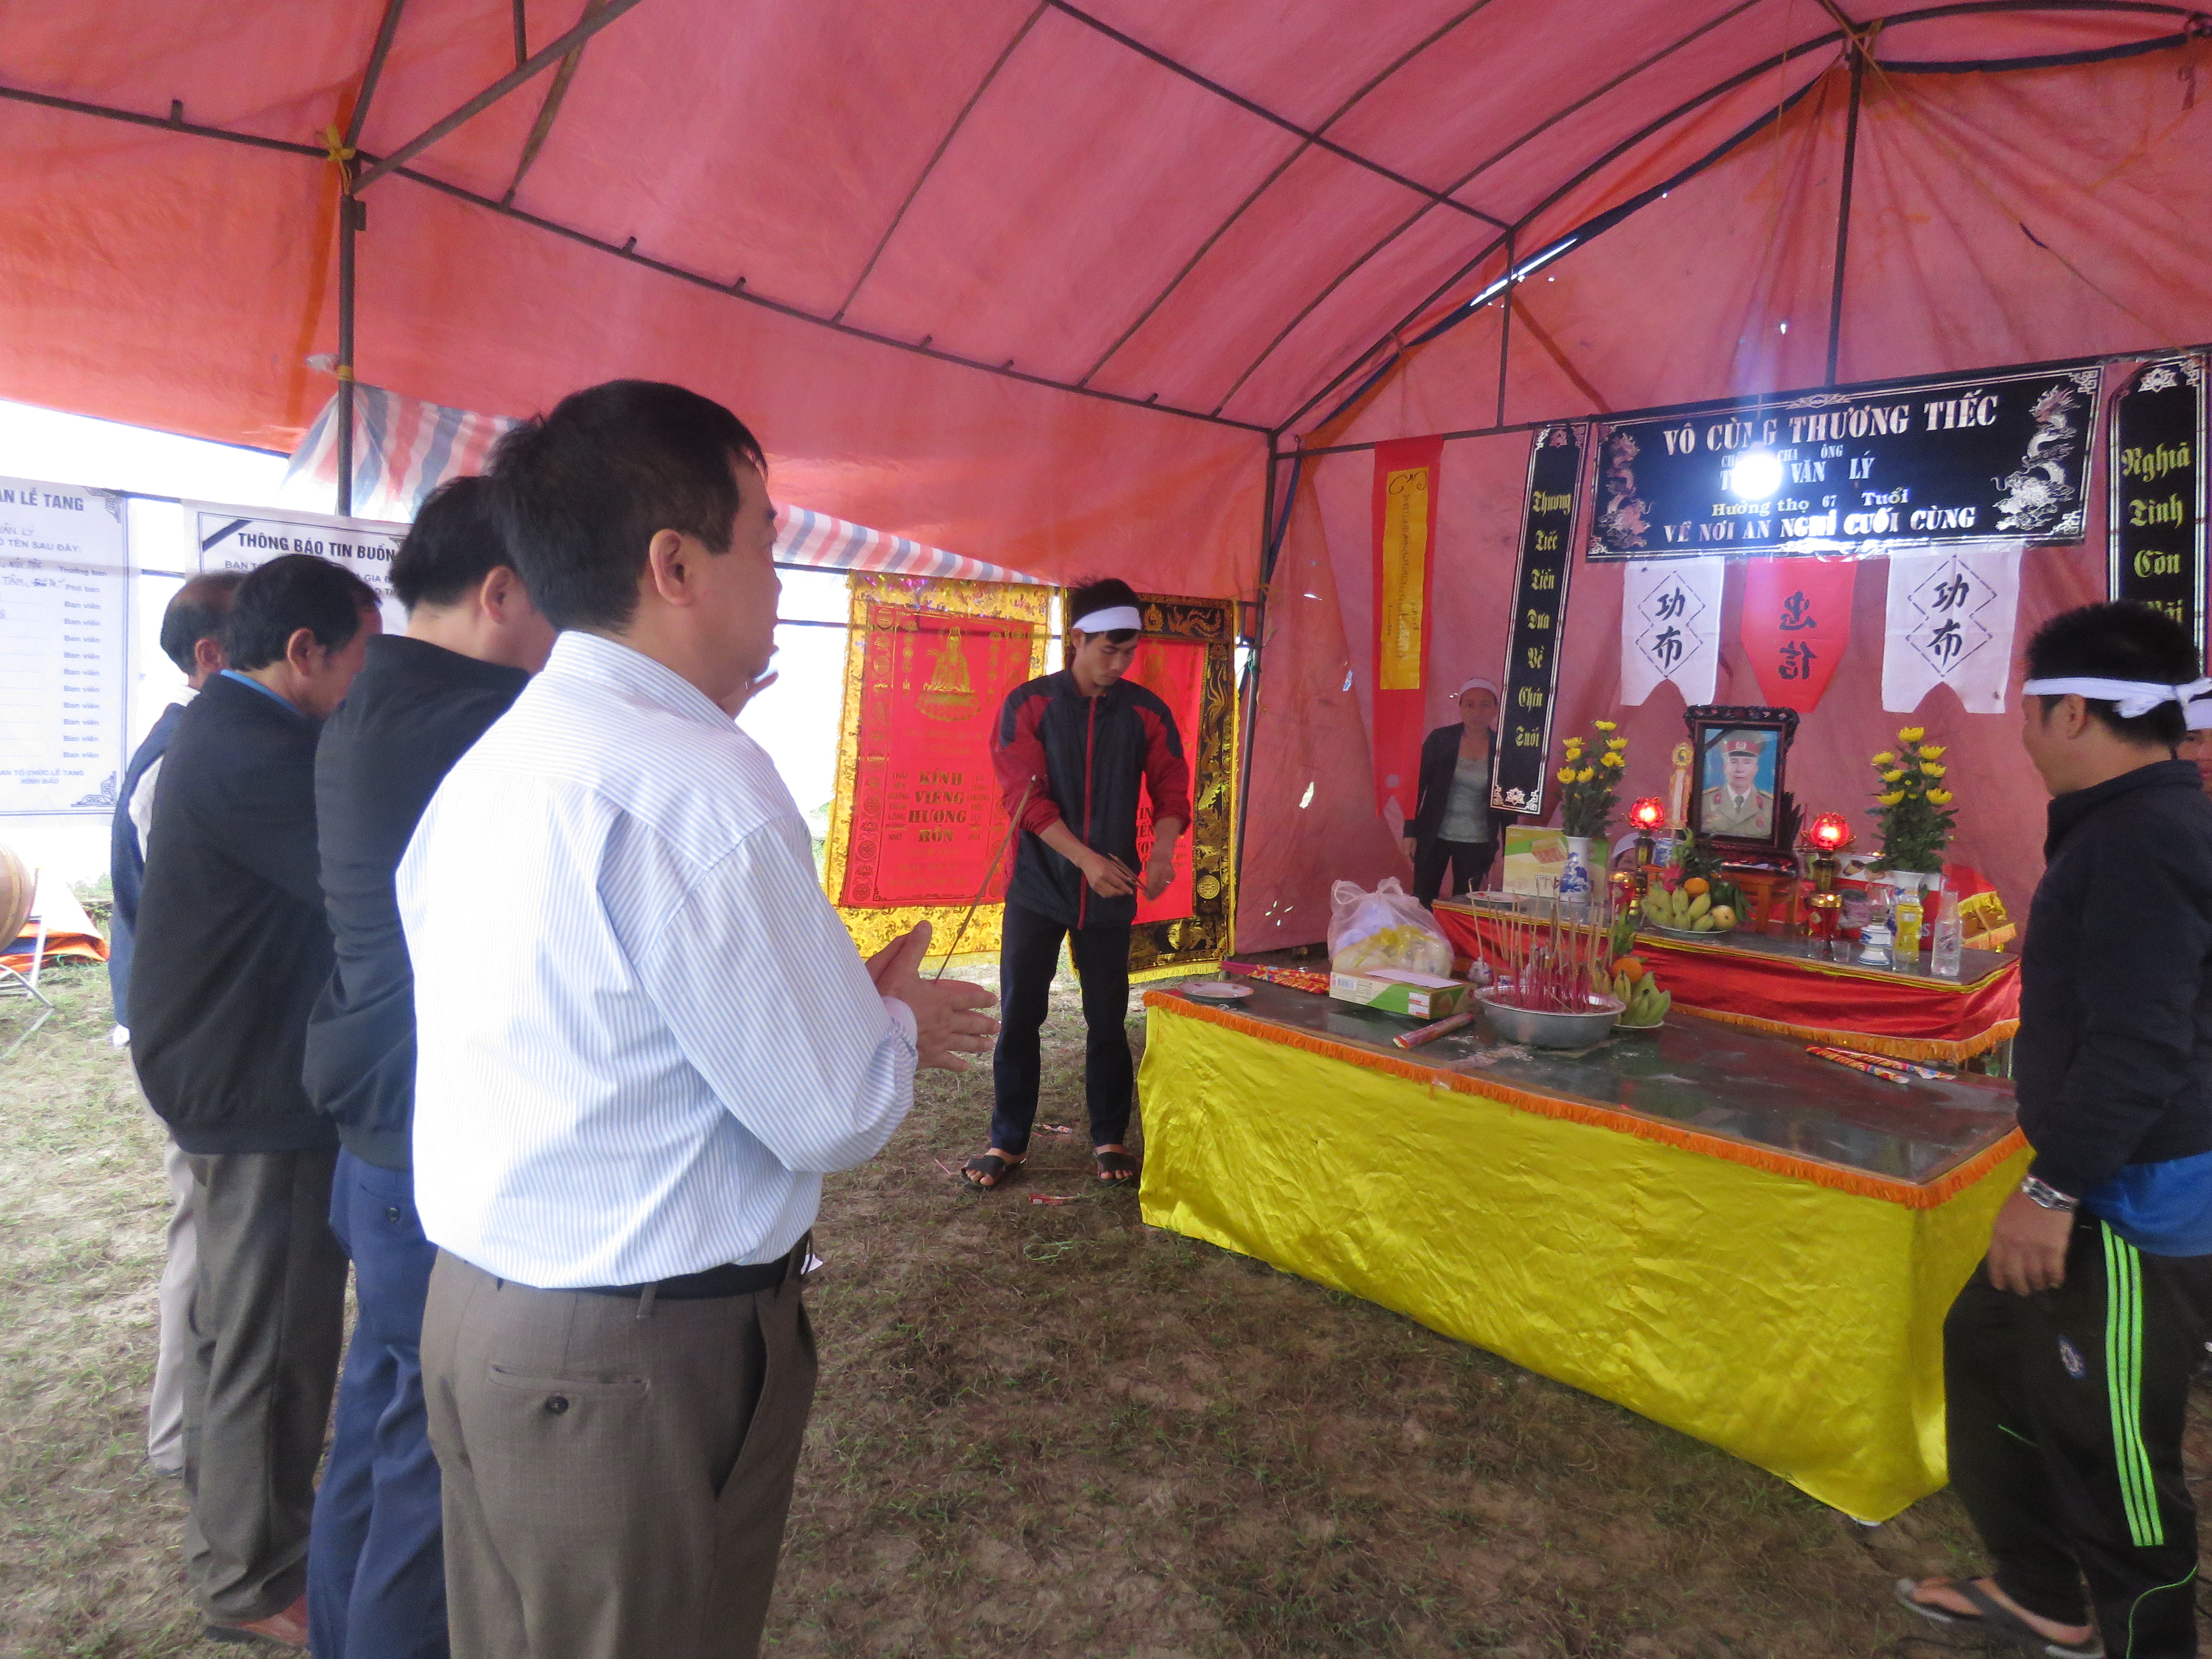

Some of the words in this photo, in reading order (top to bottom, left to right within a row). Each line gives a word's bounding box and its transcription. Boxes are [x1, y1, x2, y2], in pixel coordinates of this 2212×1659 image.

[1663, 422, 1696, 456] VÔ
[1707, 416, 1777, 451] CÙNG
[1789, 404, 1910, 444] THƯƠNG
[1923, 389, 1999, 432] TIẾC
[1820, 444, 1844, 459] ÔNG
[1791, 458, 1827, 483] VĂN
[1848, 450, 1875, 480] LÝ
[44, 493, 84, 511] TANG
[1711, 499, 1772, 517] Hưởng
[1777, 497, 1810, 514] thọ
[1822, 494, 1838, 508] 67
[1742, 519, 1772, 540] AN
[1910, 505, 1977, 530] CÙNG
[32, 541, 54, 551] SAU
[239, 532, 289, 551] THÔNG
[294, 538, 324, 555] BÁO
[328, 542, 352, 557] TIN
[225, 561, 248, 570] BAN
[364, 574, 382, 582] GIA
[920, 769, 963, 785] KÍNH
[915, 787, 964, 805] VIẾNG
